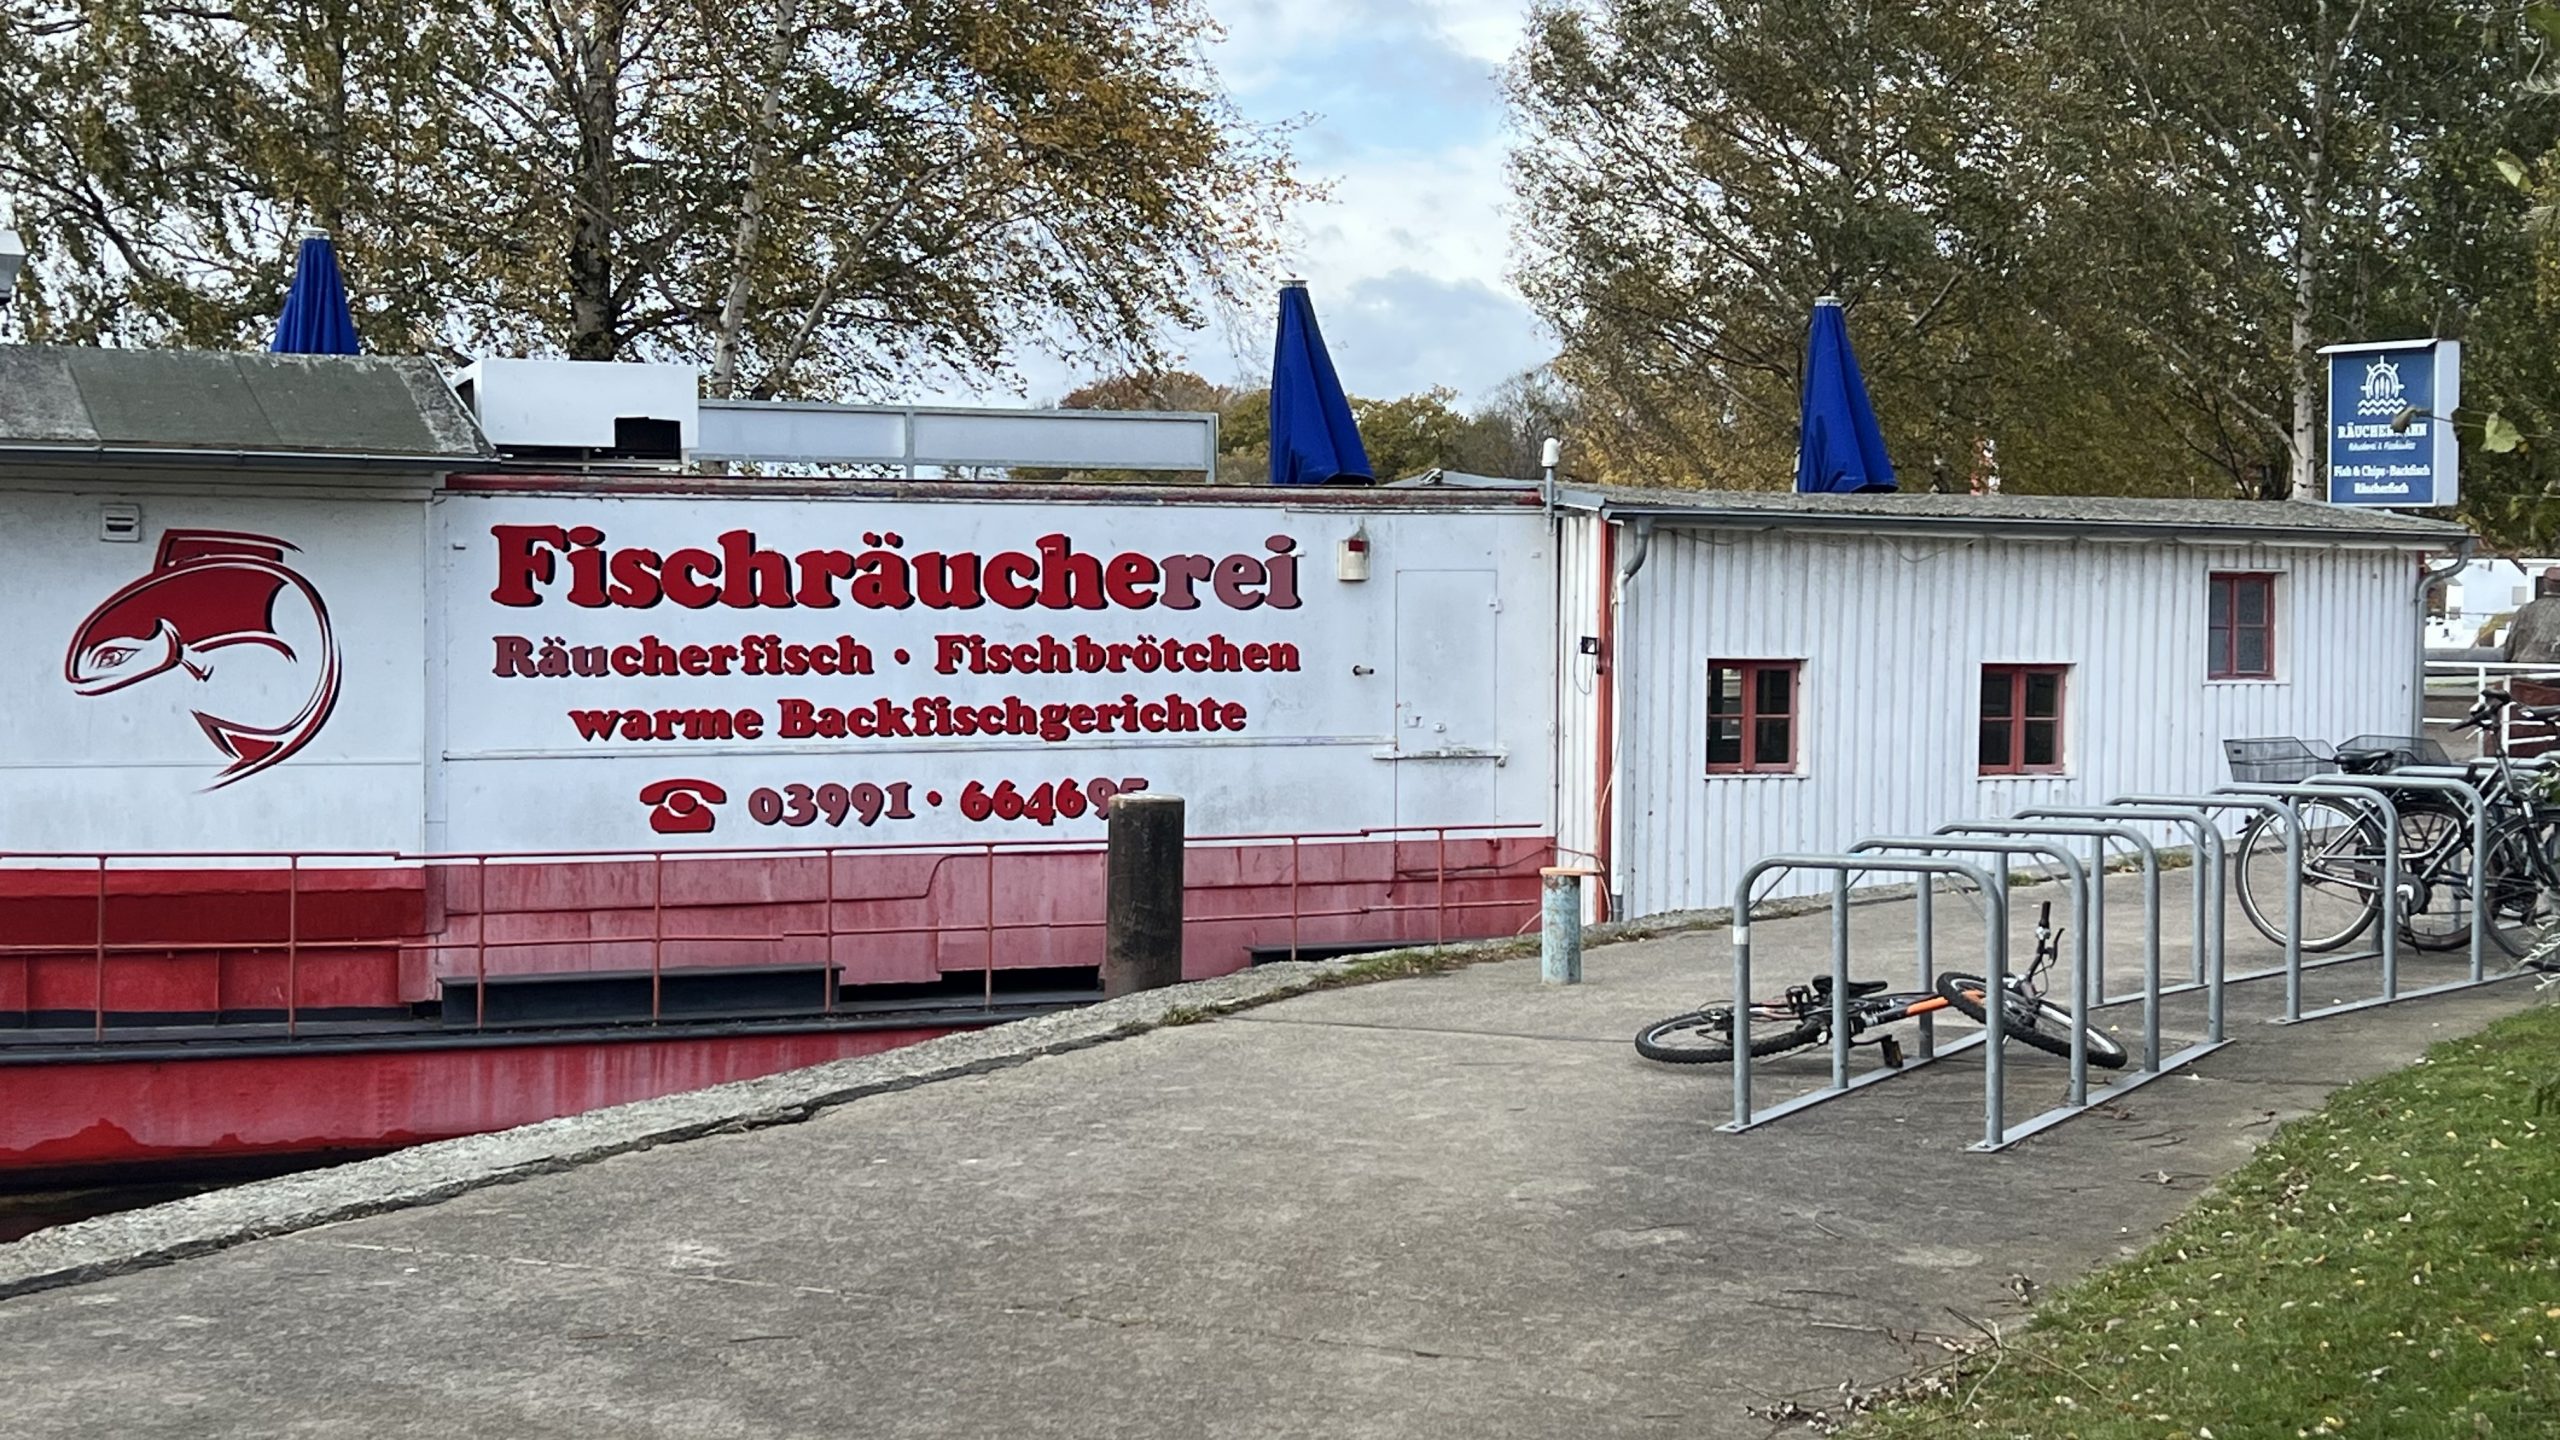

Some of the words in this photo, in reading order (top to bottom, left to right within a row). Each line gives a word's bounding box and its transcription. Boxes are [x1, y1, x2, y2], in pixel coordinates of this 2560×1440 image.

[2337, 422, 2427, 438] RÄUCHERAHN
[2334, 466, 2352, 476] Fish
[2353, 466, 2360, 476] &
[2362, 466, 2386, 479] Chips
[491, 524, 1305, 611] Fischräucherei
[491, 634, 875, 679] Räucherfisch
[933, 634, 1302, 675] Fischbrötchen
[567, 708, 764, 742] warme
[776, 693, 1247, 743] Backfischgerichte
[748, 782, 916, 828] 03991
